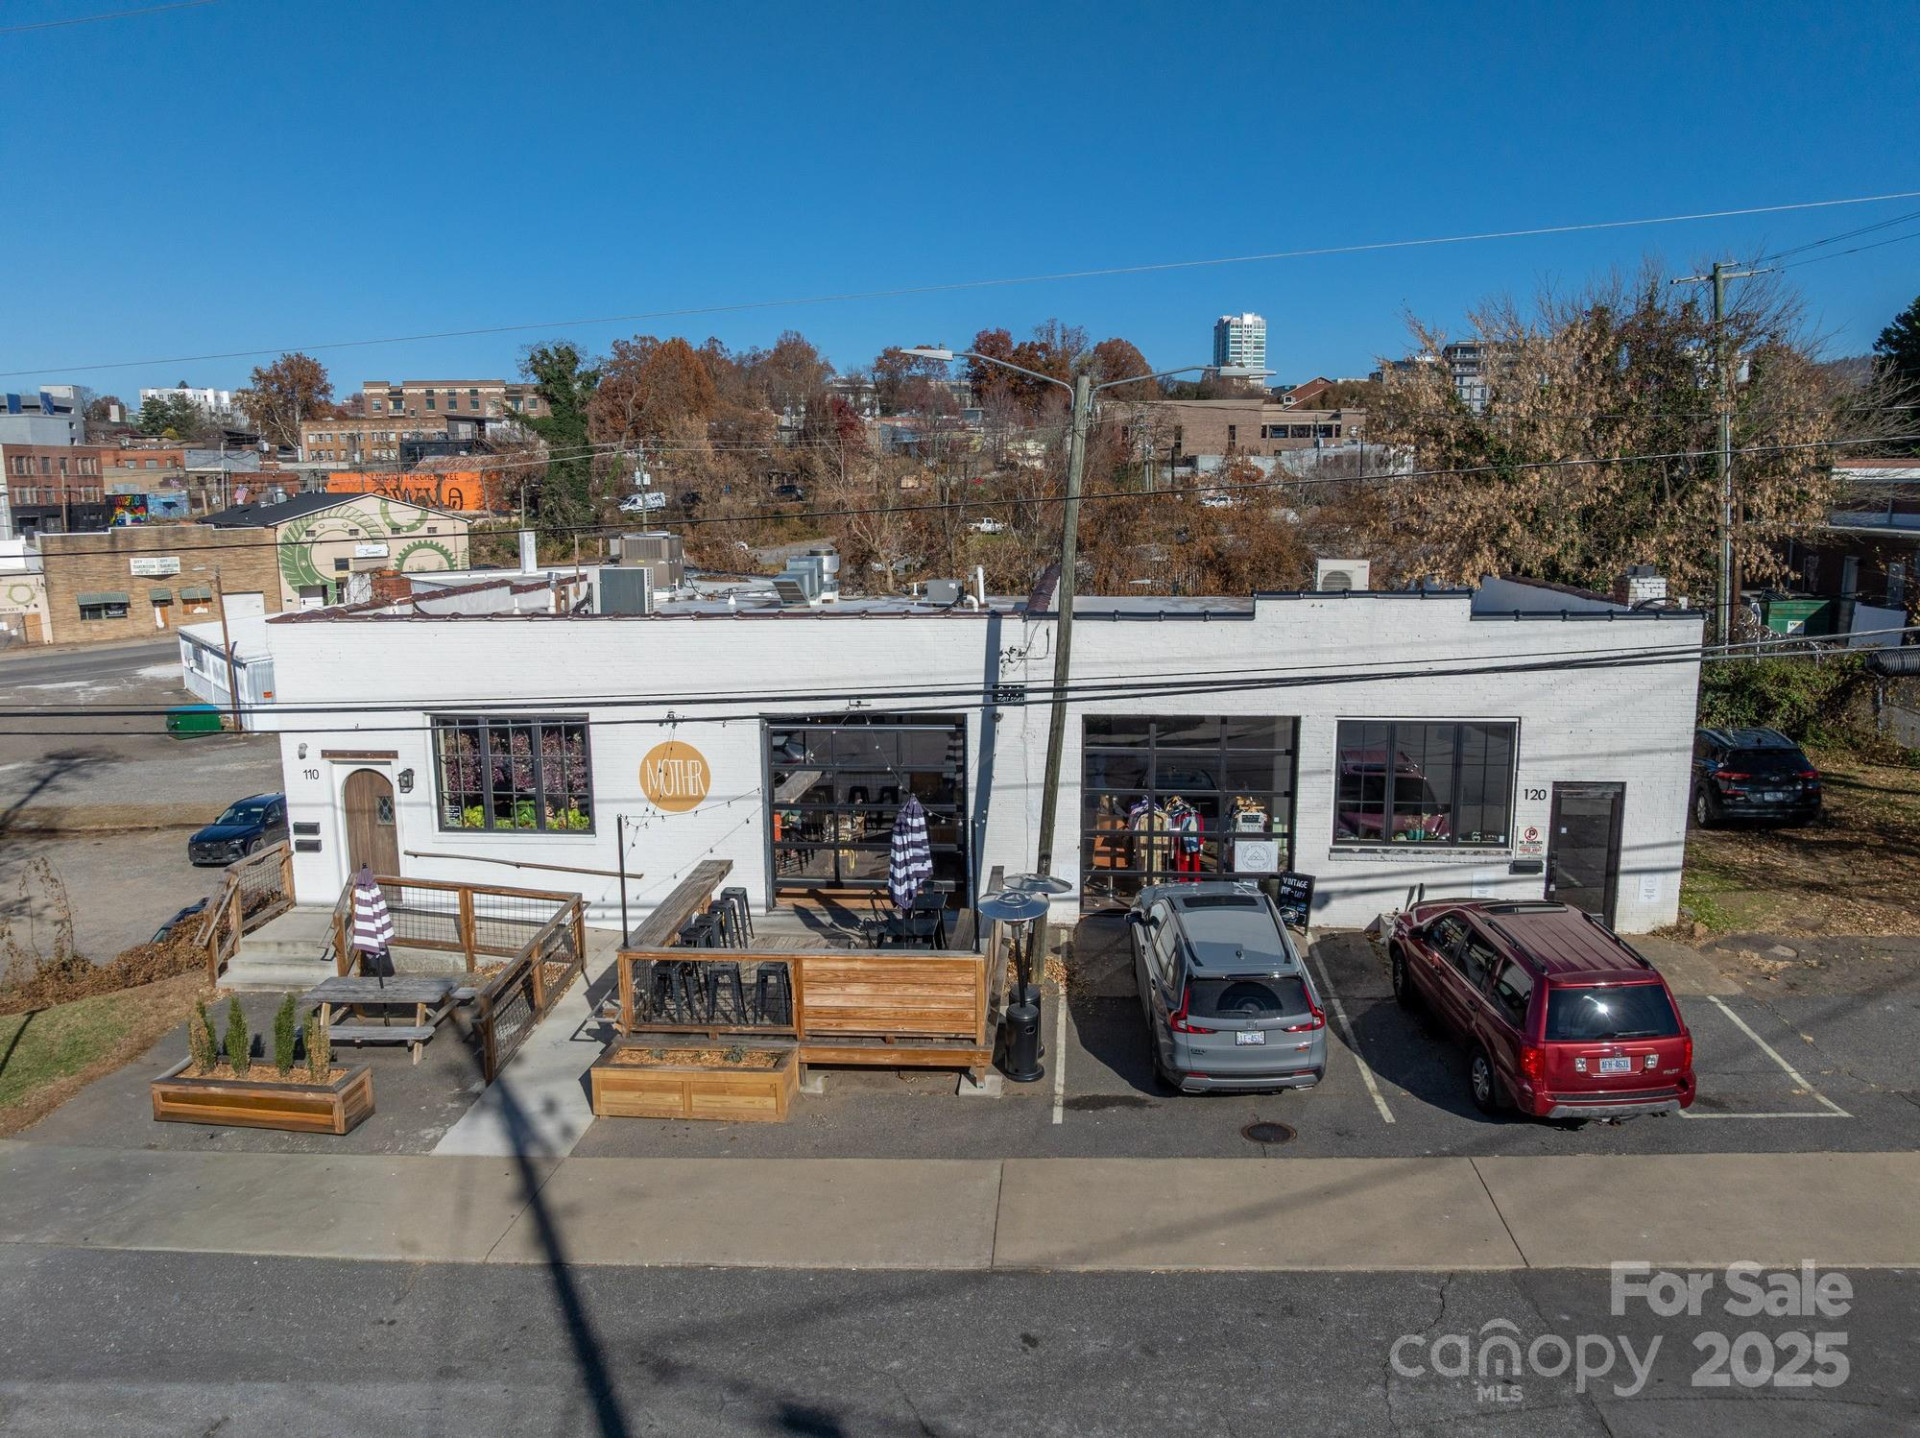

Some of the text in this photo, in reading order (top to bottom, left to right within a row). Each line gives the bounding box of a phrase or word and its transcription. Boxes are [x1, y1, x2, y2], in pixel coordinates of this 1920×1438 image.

[303, 769, 320, 780] 110
[646, 759, 706, 797] MOTHER
[1524, 788, 1547, 800] 120
[1283, 877, 1308, 889] VINTAGE
